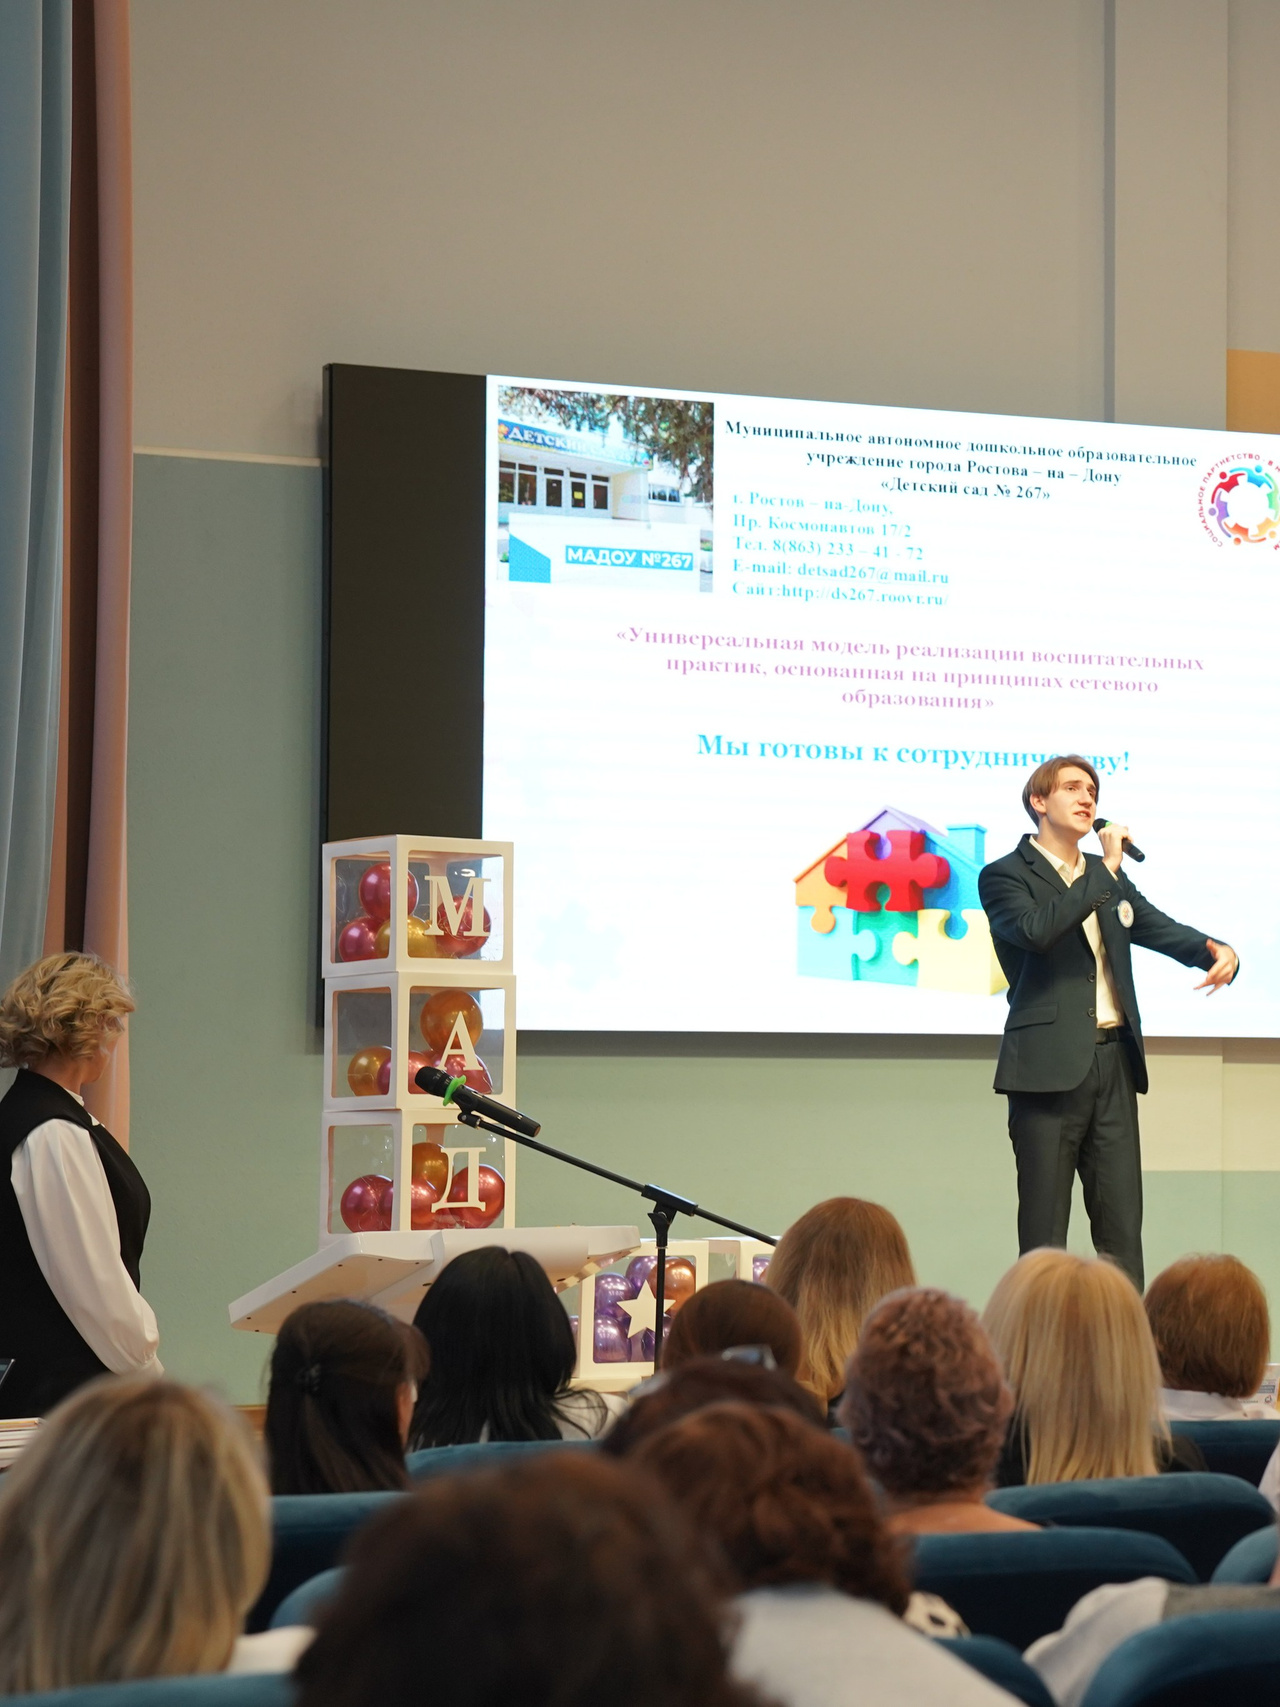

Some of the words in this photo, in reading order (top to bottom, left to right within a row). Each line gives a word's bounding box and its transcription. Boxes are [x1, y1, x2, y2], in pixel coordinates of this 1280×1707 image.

[725, 420, 862, 443] Муниципальное
[868, 434, 961, 450] автономное
[966, 441, 1064, 458] дошкольное
[1068, 446, 1197, 467] образовательное
[807, 451, 904, 469] учреждение
[909, 459, 962, 473] города
[967, 460, 1028, 477] Ростова
[1047, 469, 1065, 479] на
[1082, 468, 1122, 487] Дону
[749, 491, 805, 508] Ростов
[881, 476, 959, 495] «Детский
[963, 484, 988, 497] сад
[994, 484, 1011, 498] №
[1016, 485, 1051, 500] 267»
[733, 513, 761, 531] Пр.
[768, 516, 875, 535] Космонавтов
[567, 547, 637, 566] МАДОУ
[642, 553, 692, 569] №267
[733, 536, 767, 551] Тел.
[773, 539, 822, 557] 8(863)
[827, 542, 854, 556] 233
[873, 545, 889, 558] 41
[905, 547, 924, 560] 72
[733, 559, 792, 575] E-mail:
[797, 562, 949, 584] detsad267@mail.ru
[617, 627, 804, 651] «Универсальная
[811, 639, 890, 656] модель
[896, 644, 1024, 663] реализации
[1032, 650, 1204, 671] воспитательных
[666, 657, 767, 677] практик,
[774, 663, 904, 682] основанная
[912, 670, 937, 683] на
[944, 671, 1063, 690] принципах
[1069, 677, 1158, 693] сетевого
[842, 689, 994, 710] образования»
[697, 733, 749, 756] Мы
[759, 742, 863, 761] готовы
[873, 748, 888, 762] к
[424, 875, 492, 937] М
[437, 1010, 484, 1072] А
[431, 1147, 486, 1213] Д
